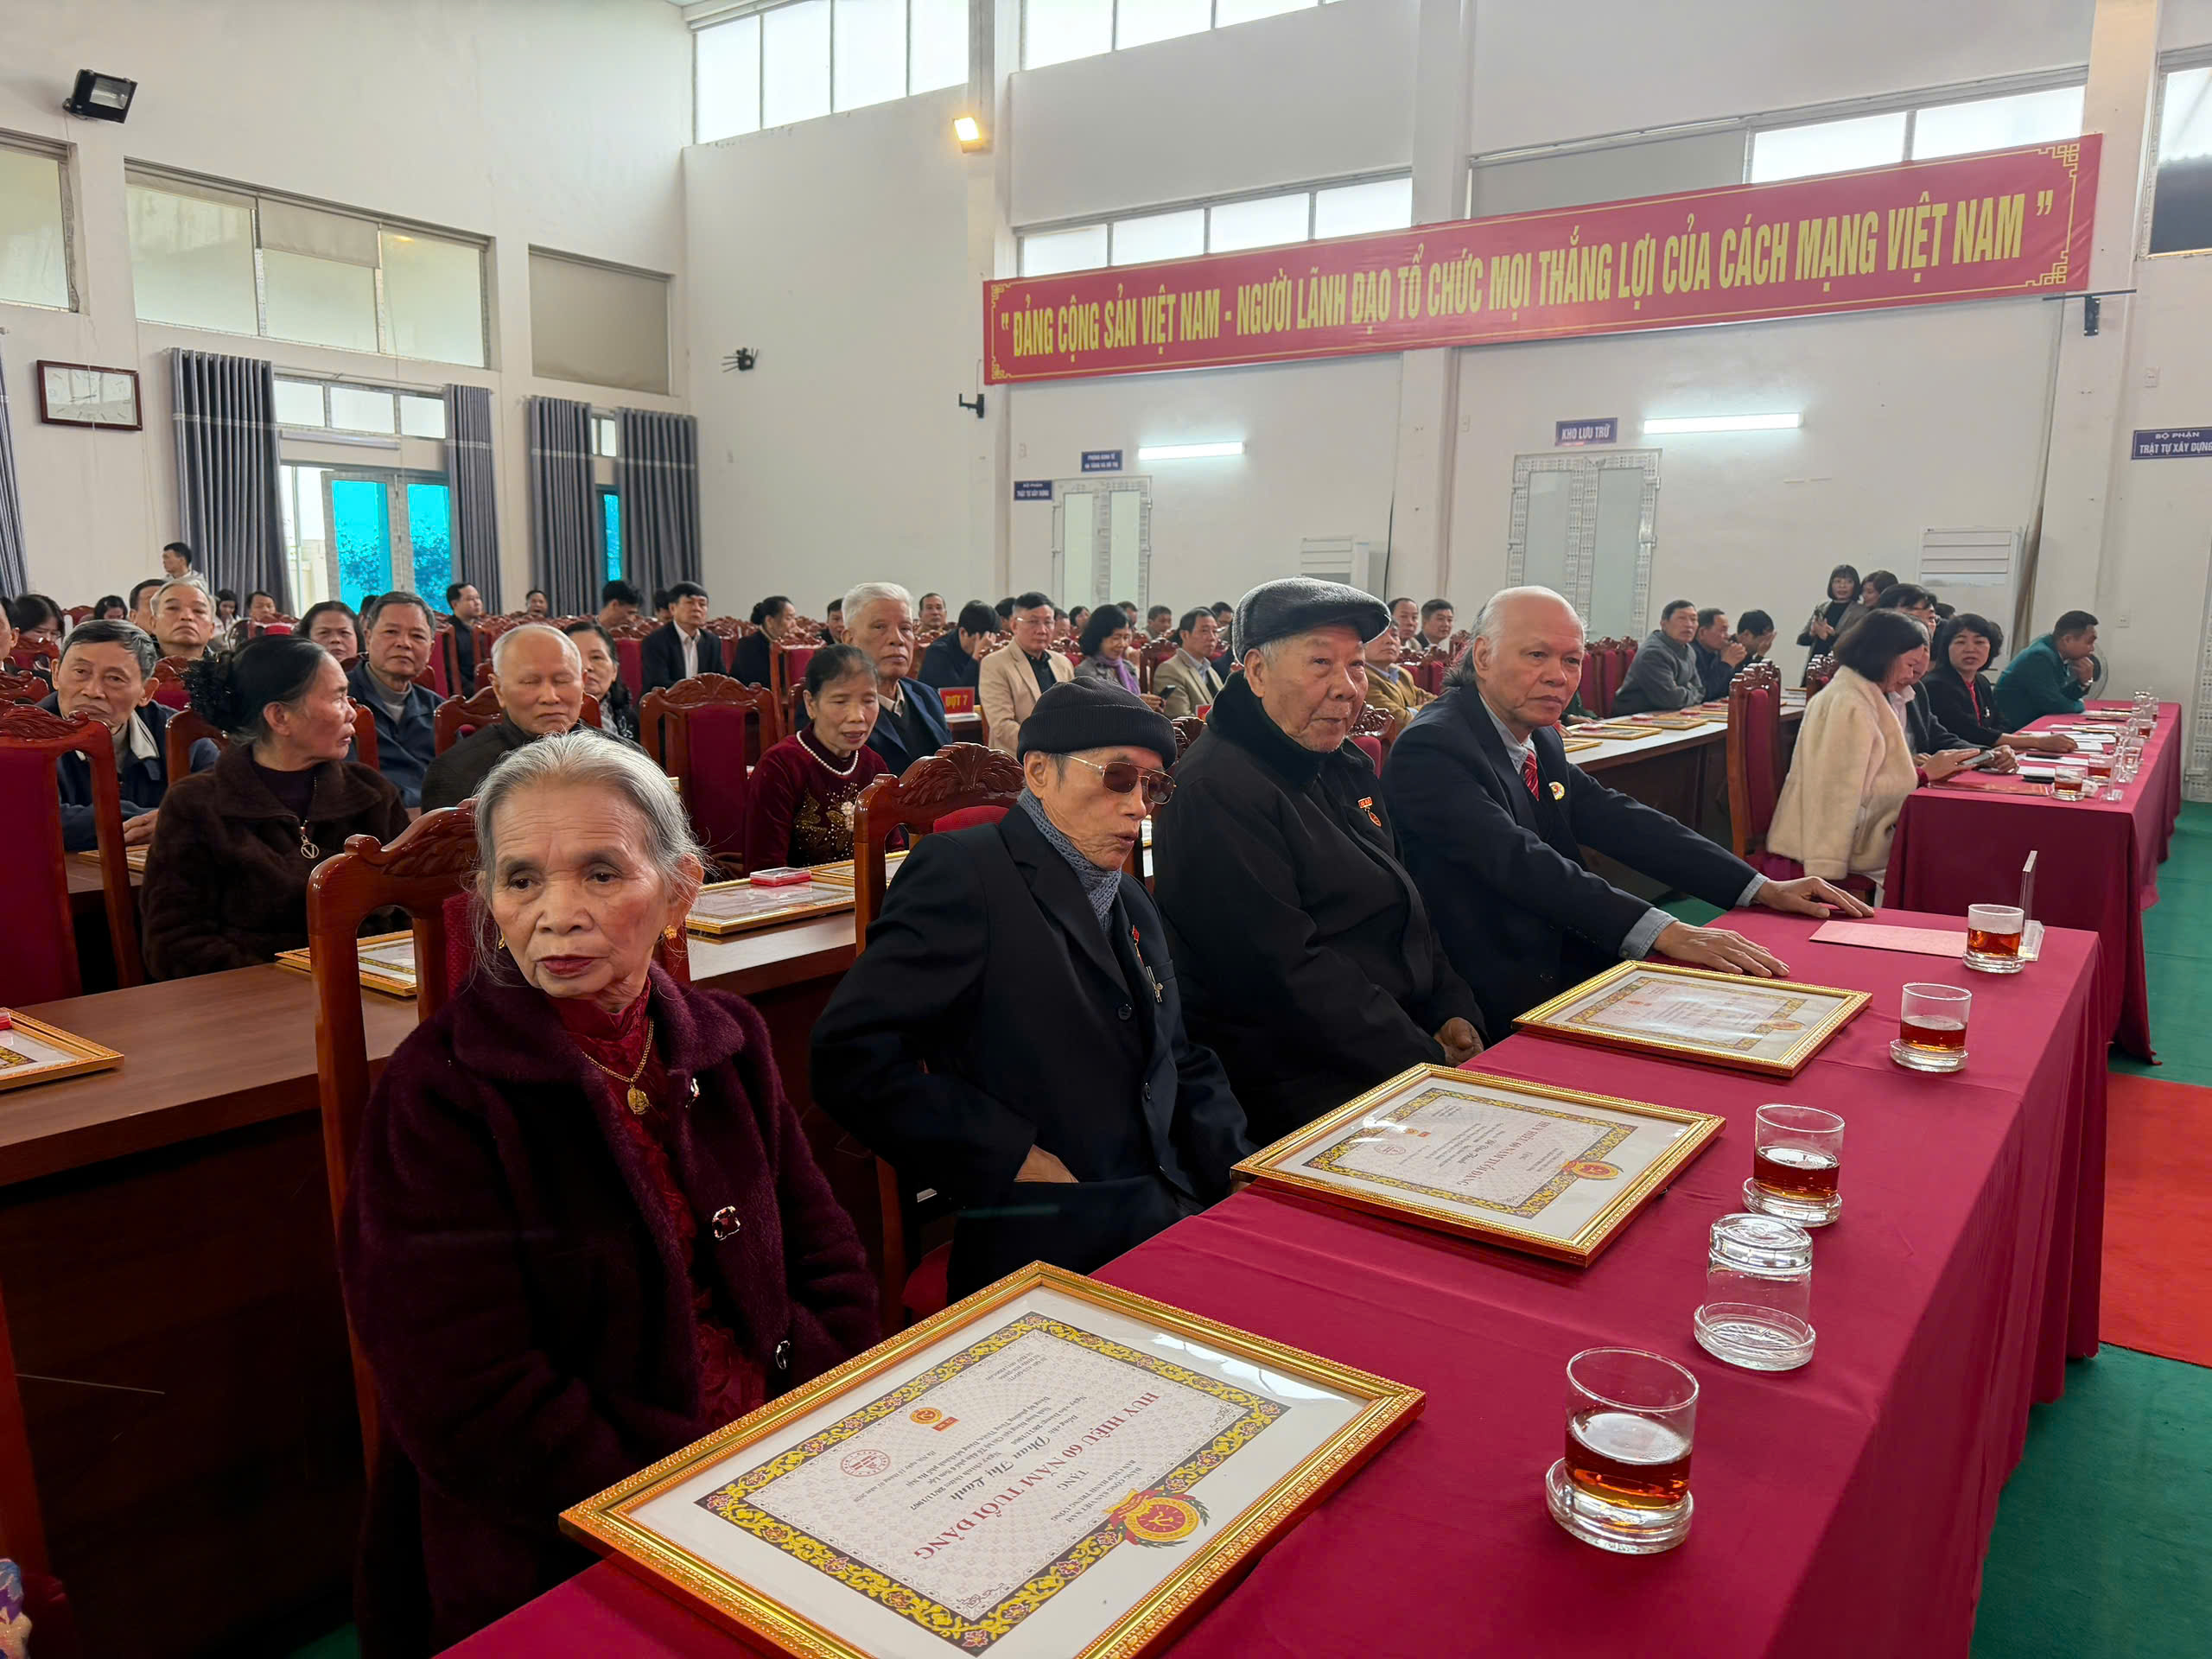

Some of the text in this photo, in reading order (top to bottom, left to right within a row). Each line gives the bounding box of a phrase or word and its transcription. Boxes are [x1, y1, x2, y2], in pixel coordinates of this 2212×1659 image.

[1013, 293, 1053, 357] ĐẢNG
[1058, 294, 1099, 363] CỘNG
[1103, 283, 1137, 349] SẢN
[1141, 283, 1176, 354] VIỆT
[1179, 289, 1220, 341] NAM
[1236, 268, 1292, 336] NGƯỜI
[1297, 266, 1347, 329] LÃNH
[1351, 268, 1391, 335] ĐẠO
[1397, 243, 1425, 320] TỔ
[1427, 248, 1484, 317] CHỨC
[1489, 252, 1532, 321] MỌI
[1538, 225, 1612, 306] THẮNG
[1618, 232, 1656, 310] LỢI
[1662, 213, 1711, 295] CỦA
[1719, 213, 1789, 289] CÁCH
[1795, 211, 1878, 292] MẠNG
[1887, 191, 1948, 283] VIỆT
[1952, 193, 2025, 264] NAM
[1562, 427, 1577, 440] KHO
[2139, 442, 2159, 455] TRẬT
[2161, 443, 2172, 454] TỰ
[1012, 1436, 1050, 1459] Phan
[913, 1392, 1159, 1559] HUY HIỆU 60 NĂM TUỔI ĐẢNG
[984, 1462, 1014, 1478] Thị
[1056, 1470, 1089, 1490] TẶNG
[950, 1476, 984, 1500] Lành
